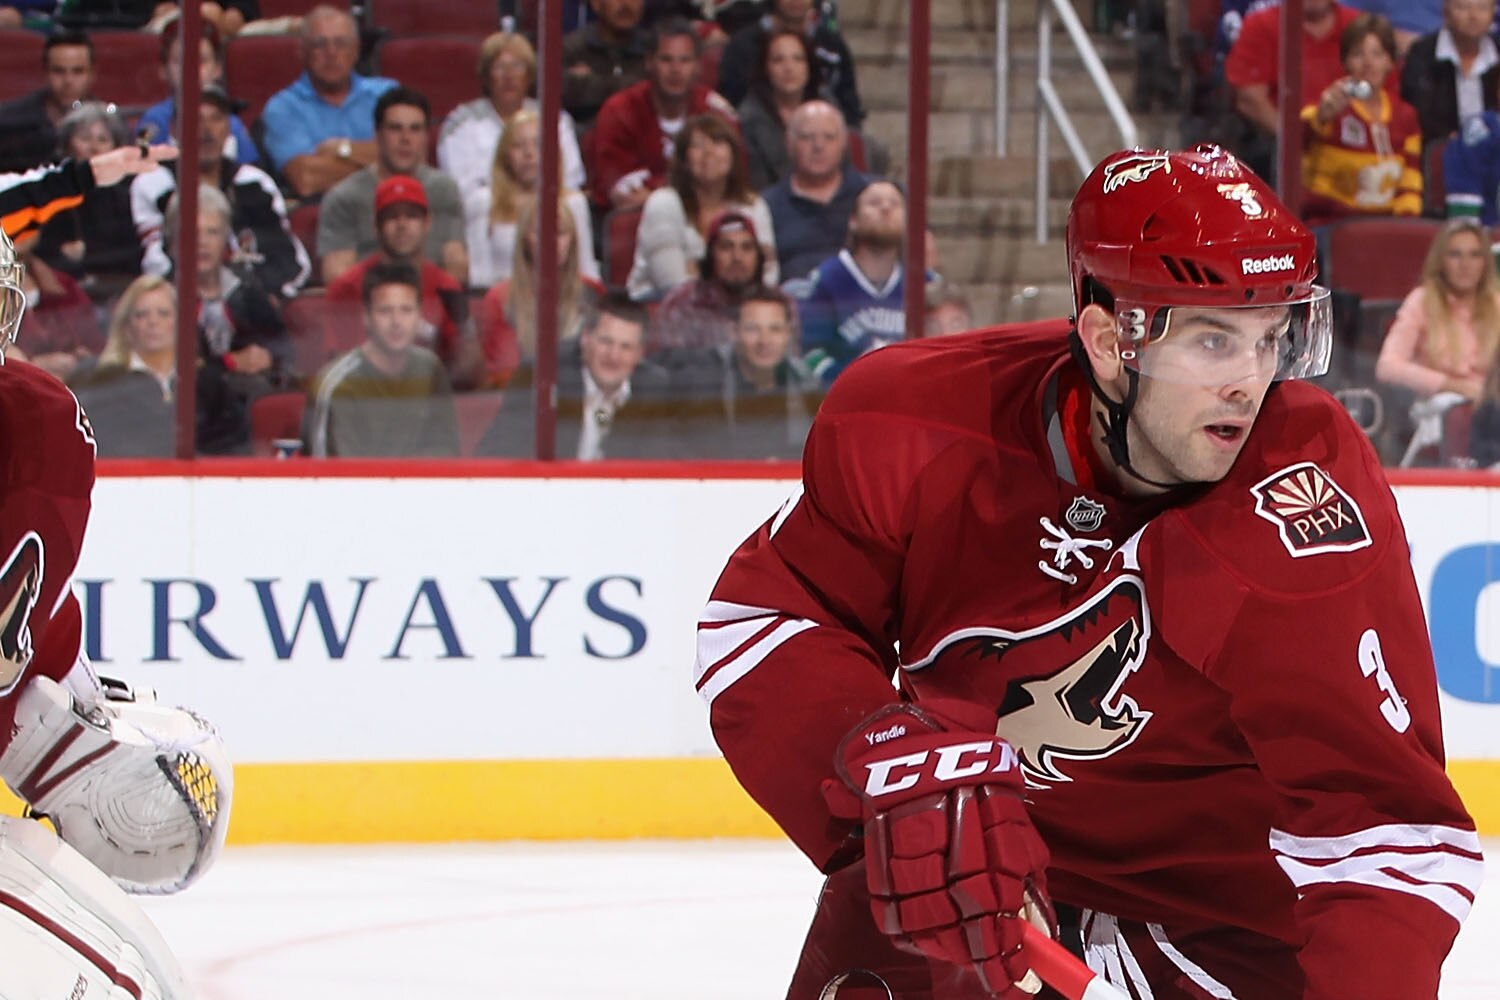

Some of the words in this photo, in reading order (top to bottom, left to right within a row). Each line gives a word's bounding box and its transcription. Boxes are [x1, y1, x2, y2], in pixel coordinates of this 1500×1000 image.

[1242, 254, 1294, 275] Reebok
[1293, 501, 1353, 544] PHX
[74, 575, 648, 662] IRWAYS
[1358, 628, 1411, 733] 3
[865, 725, 906, 746] Yandle
